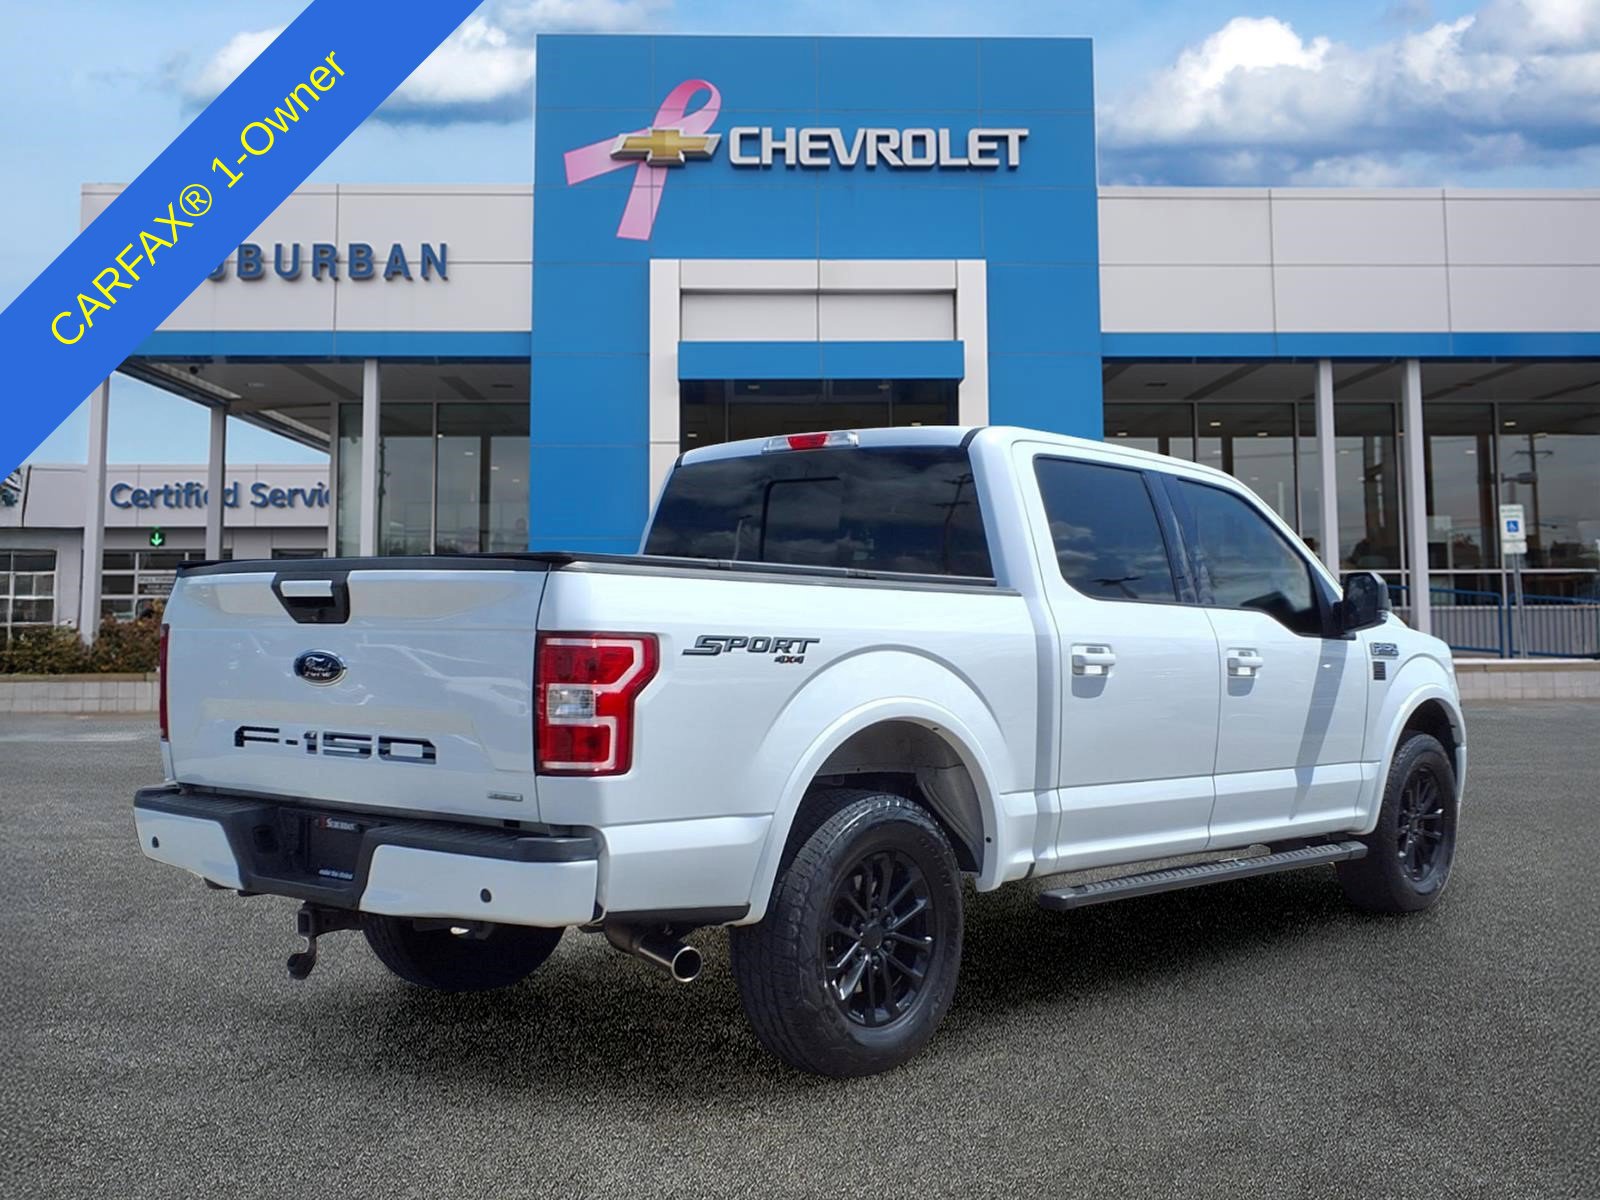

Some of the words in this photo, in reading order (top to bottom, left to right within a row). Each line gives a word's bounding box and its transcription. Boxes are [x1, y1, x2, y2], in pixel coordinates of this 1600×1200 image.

[728, 126, 1030, 169] CHEVROLET
[110, 481, 240, 509] Certifid
[682, 634, 821, 656] SPORT
[234, 725, 437, 765] F-150
